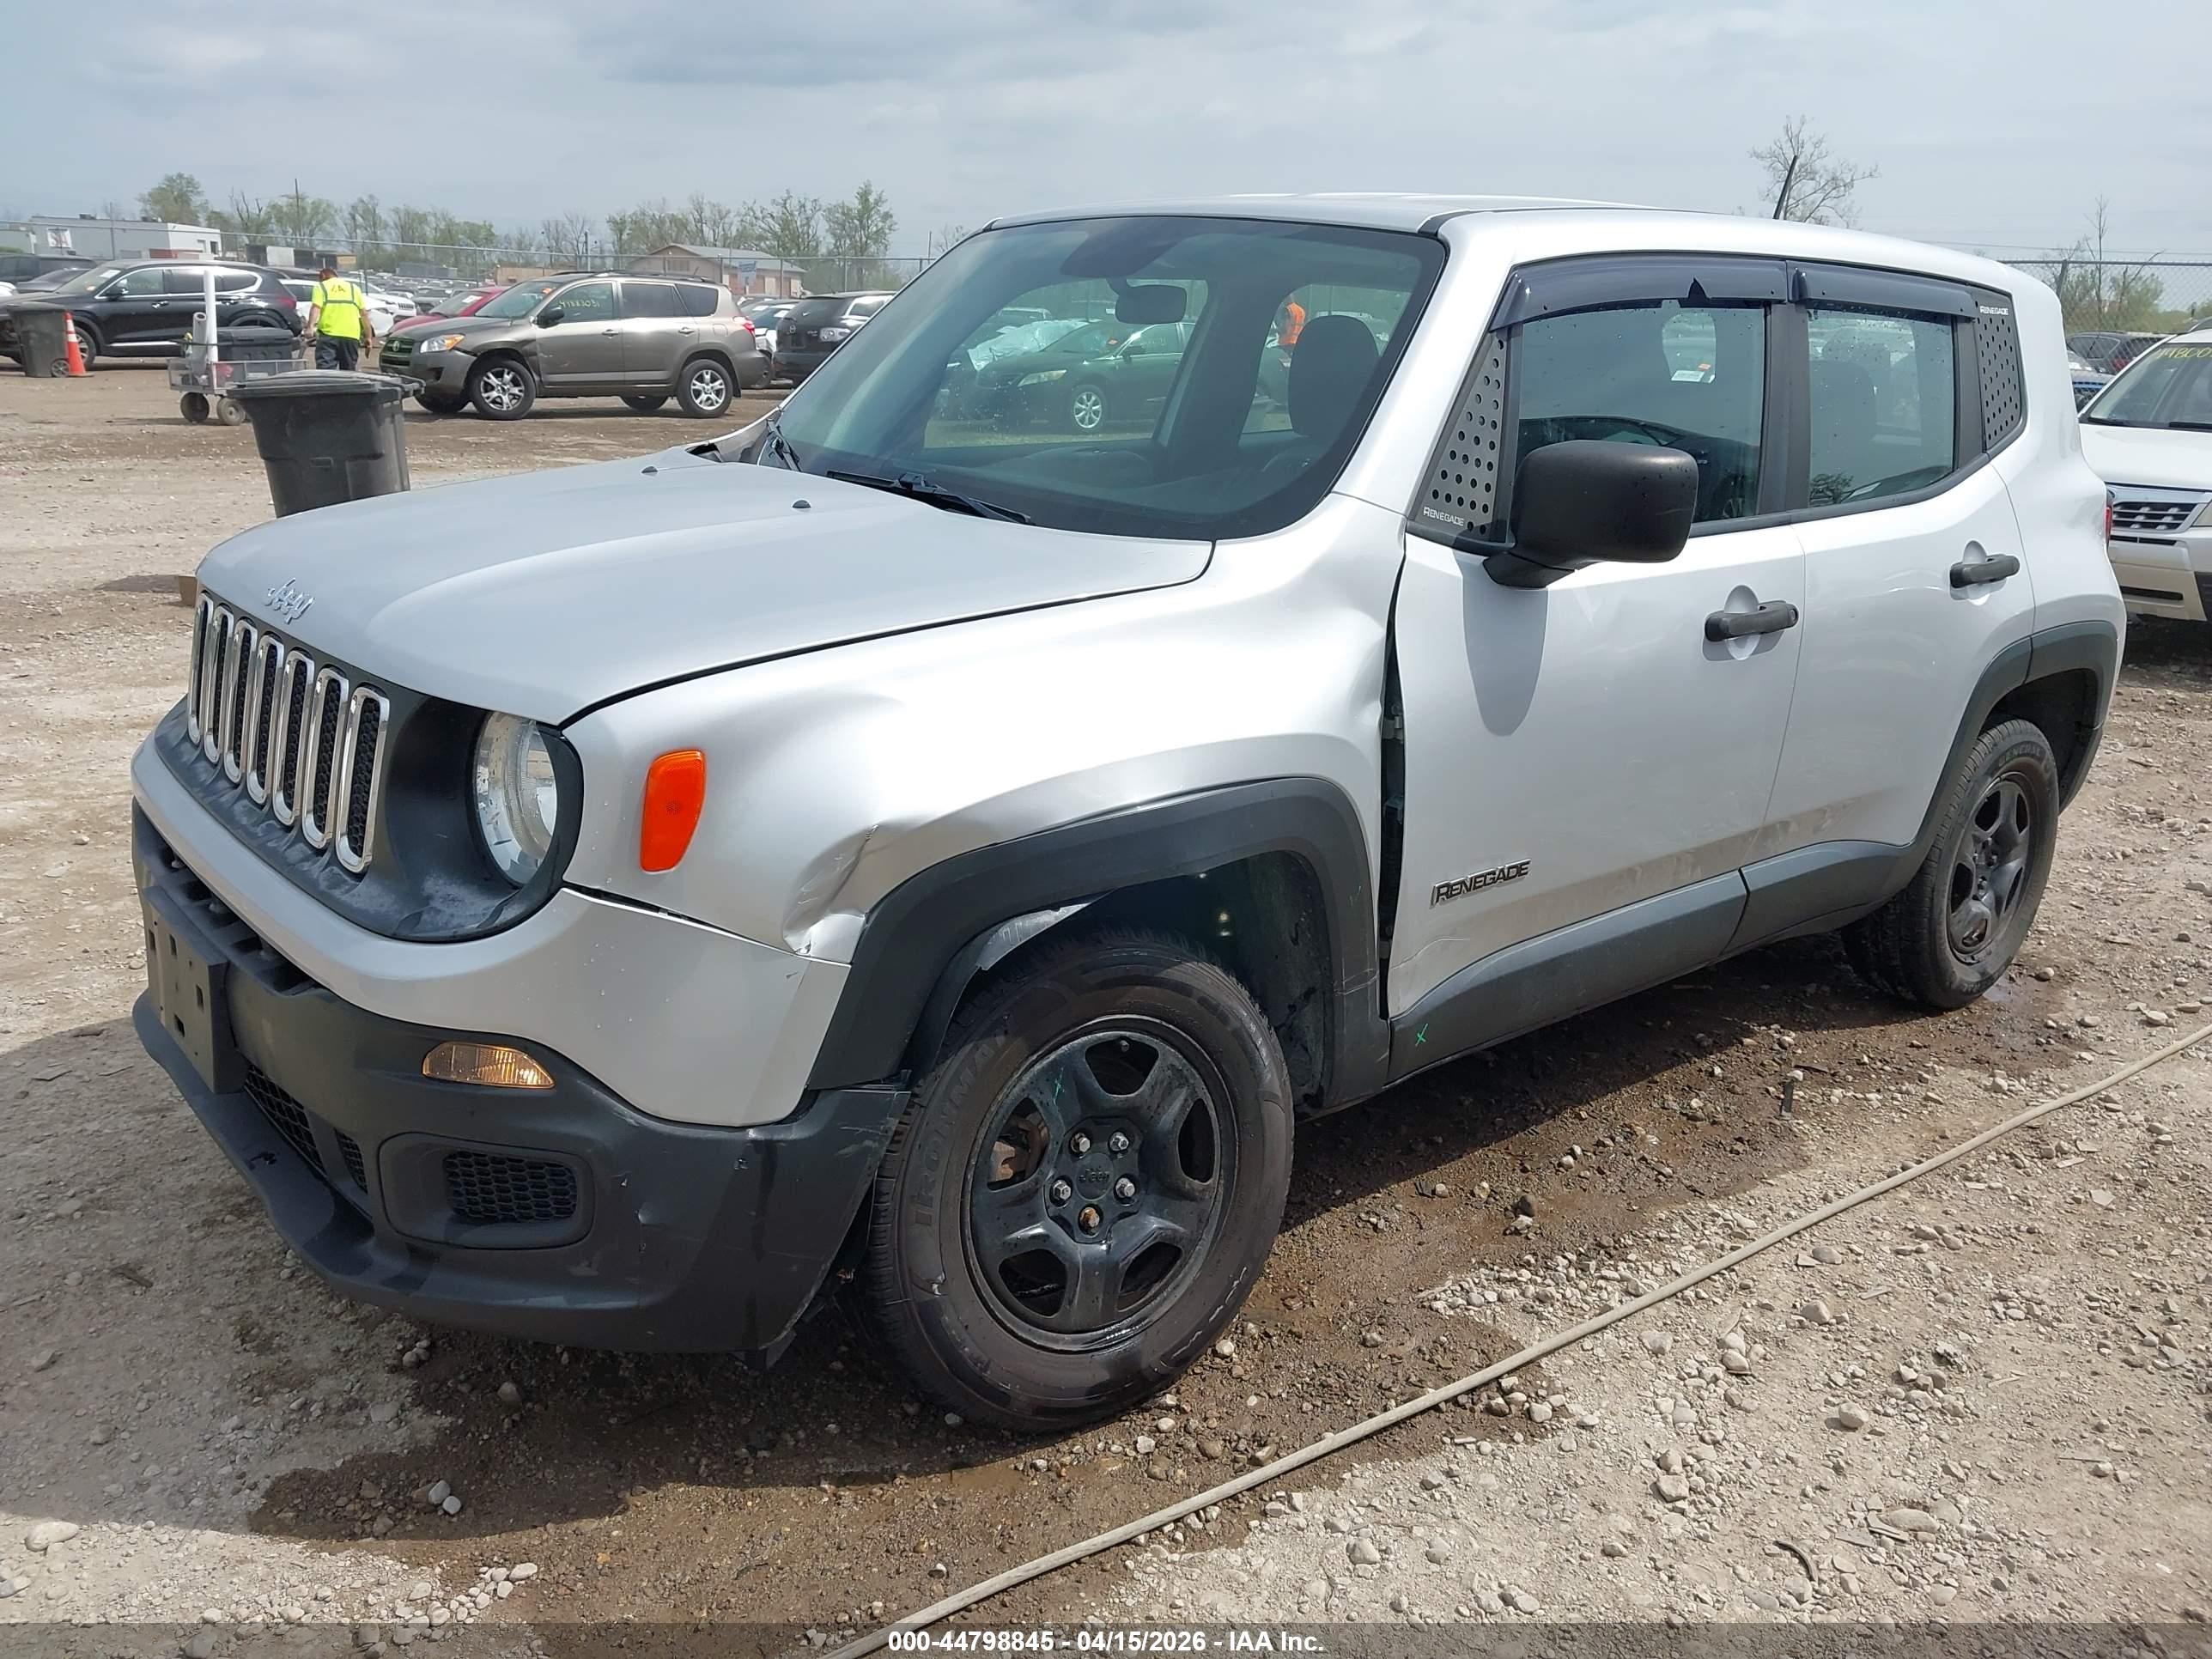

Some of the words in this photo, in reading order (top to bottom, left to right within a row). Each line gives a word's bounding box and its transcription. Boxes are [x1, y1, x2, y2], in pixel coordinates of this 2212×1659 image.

[1979, 305, 2009, 316] RENEGADE
[1423, 506, 1465, 526] RENEGADE
[262, 577, 315, 625] Jeep
[1430, 859, 1532, 908] RENEGADE
